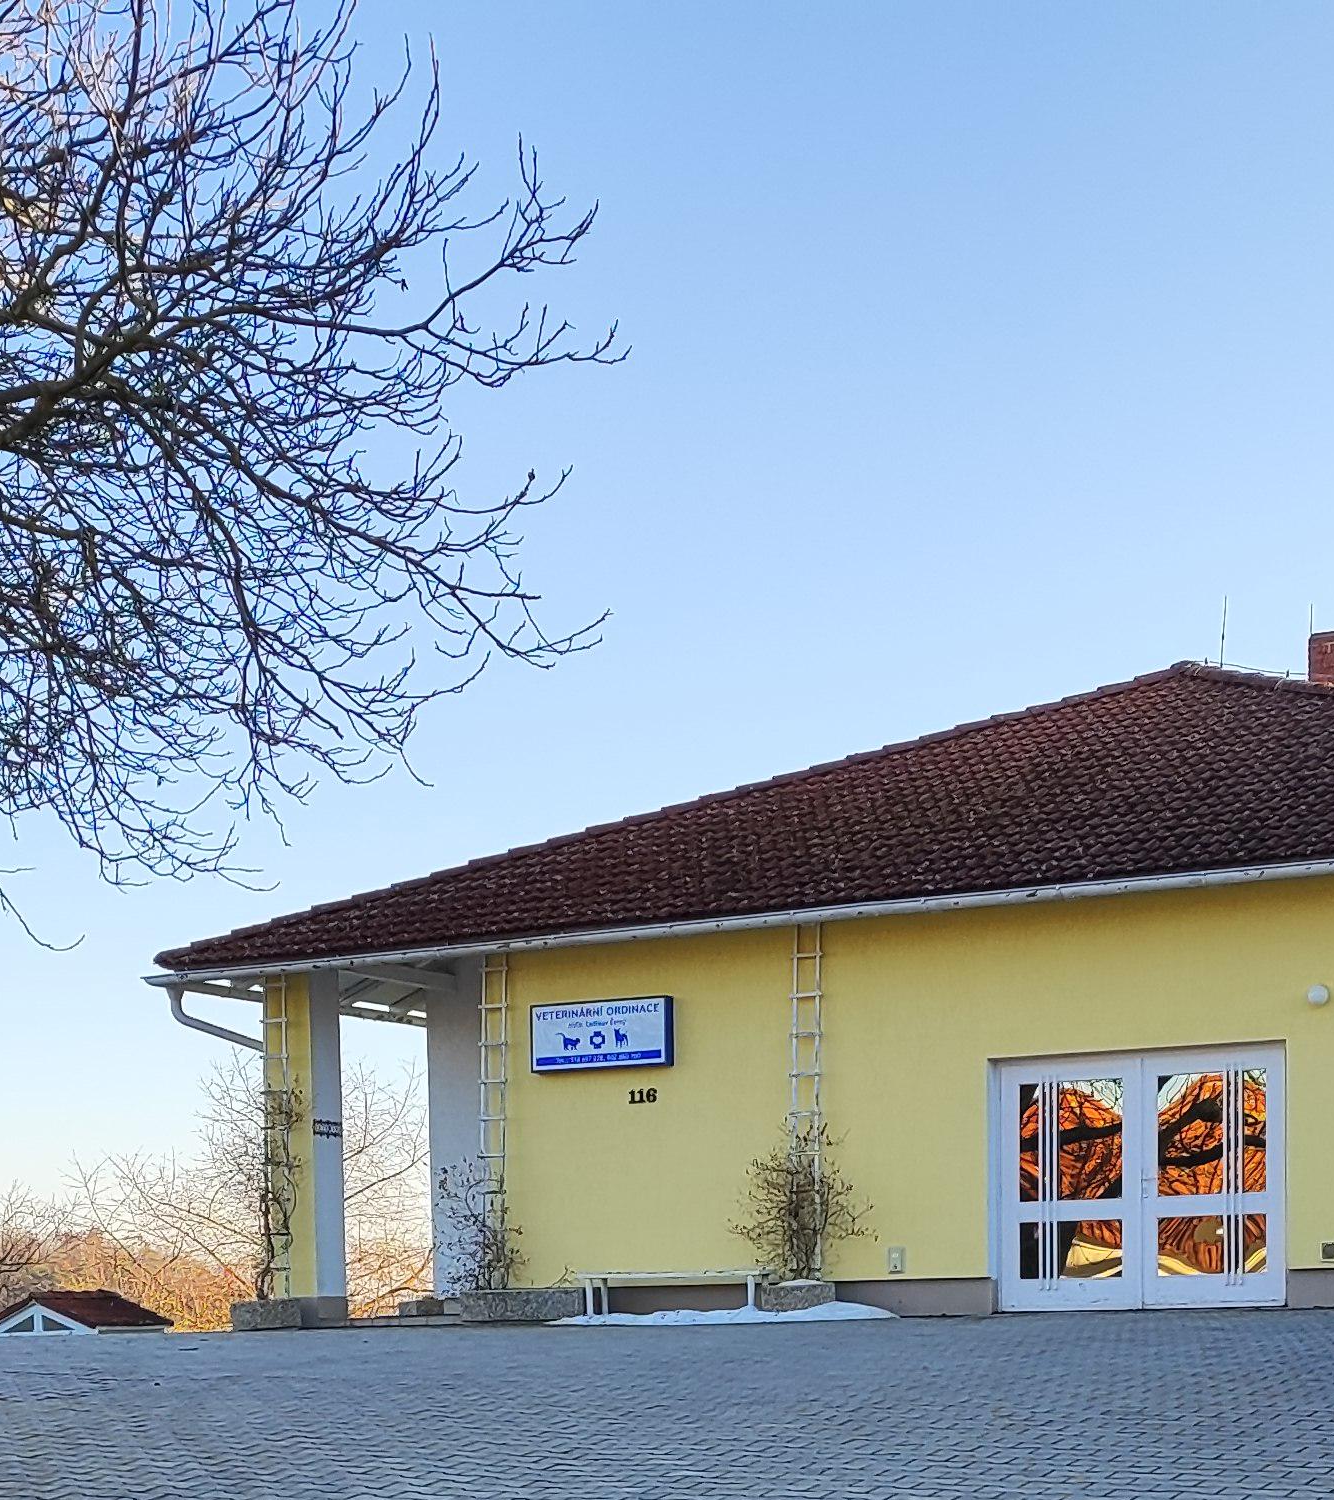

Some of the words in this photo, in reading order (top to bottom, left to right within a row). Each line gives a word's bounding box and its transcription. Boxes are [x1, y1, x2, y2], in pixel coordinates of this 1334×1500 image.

[535, 1005, 603, 1021] VETERINÁRNÍ
[606, 1003, 660, 1016] ORDINACE
[628, 1087, 658, 1104] 116
